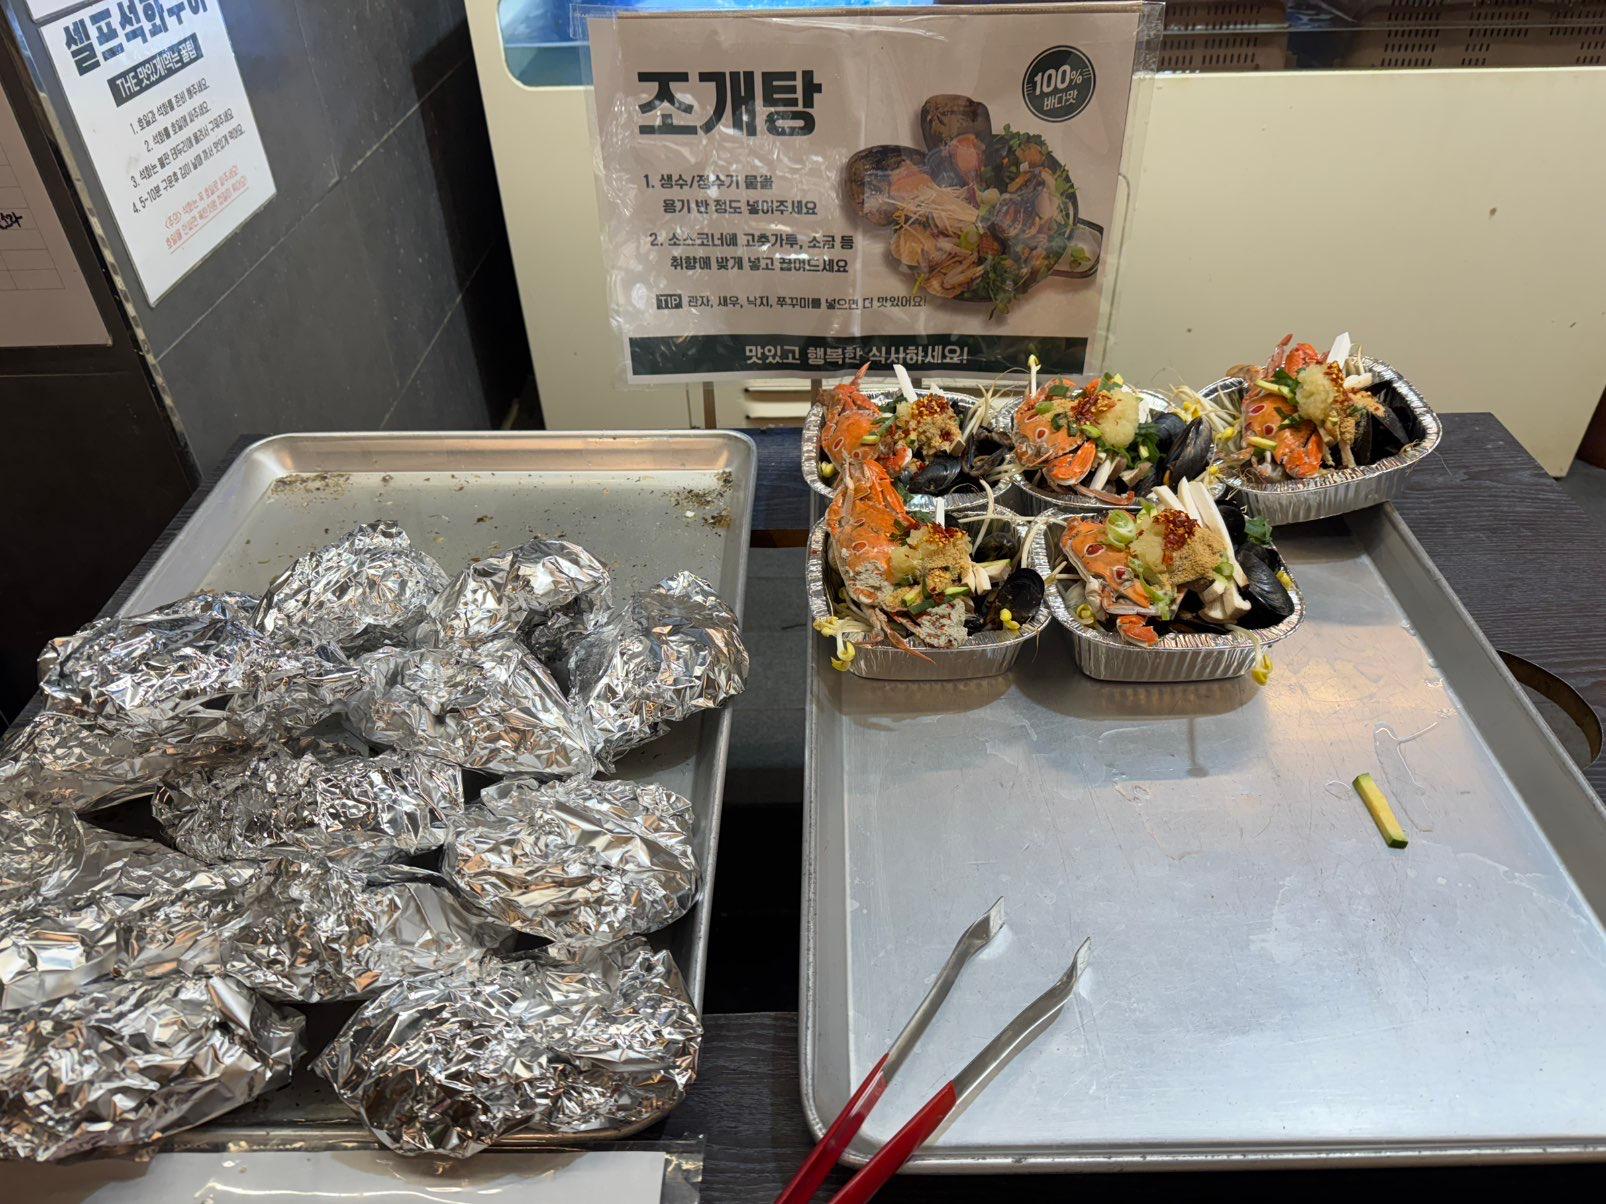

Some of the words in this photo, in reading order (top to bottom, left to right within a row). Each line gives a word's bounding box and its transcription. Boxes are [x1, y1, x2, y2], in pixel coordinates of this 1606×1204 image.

[116, 75, 140, 98] THE
[179, 38, 197, 63] 꿀팁
[1034, 64, 1082, 96] 100%
[130, 122, 139, 135] 1.
[137, 110, 157, 131] 호일과
[156, 98, 175, 117] 석화를
[174, 90, 187, 108] 준비
[637, 70, 823, 137] 조개탕
[1043, 89, 1078, 110] 바다맛
[144, 140, 153, 152] 2.
[152, 126, 171, 145] 석화를
[170, 114, 189, 135] 호일에
[131, 175, 140, 188] 3.
[139, 163, 159, 181] 석화는
[170, 135, 194, 160] 테두리에
[161, 171, 180, 191] 구운후
[212, 134, 229, 153] 맛있게
[643, 174, 655, 189] 1.
[659, 174, 740, 190] 생수/정수기
[745, 174, 773, 190] 물을
[663, 199, 691, 214] 용기
[696, 199, 709, 214] 반
[715, 199, 742, 214] 정도
[747, 200, 818, 215] 넣어주세요
[650, 233, 663, 247] 2.
[668, 233, 738, 247] 소스코너에
[808, 234, 836, 249] 소금
[841, 235, 854, 249] 등
[670, 256, 711, 270] 취향에
[716, 256, 743, 270] 맞게
[748, 256, 775, 270] 넣고
[779, 258, 848, 273] 끓여드세요
[658, 296, 680, 308] TIP
[688, 296, 713, 308] 관자,
[717, 296, 743, 308] 새우,
[747, 296, 772, 309] 낙지,
[776, 297, 821, 309] 쭈꾸미를
[826, 298, 859, 310] 넣으면
[863, 298, 873, 309] 더
[877, 296, 926, 308] 맛있어요!
[745, 345, 800, 364] 맛있고
[807, 345, 863, 365] 행복한
[869, 345, 967, 365] 식사하세요!
